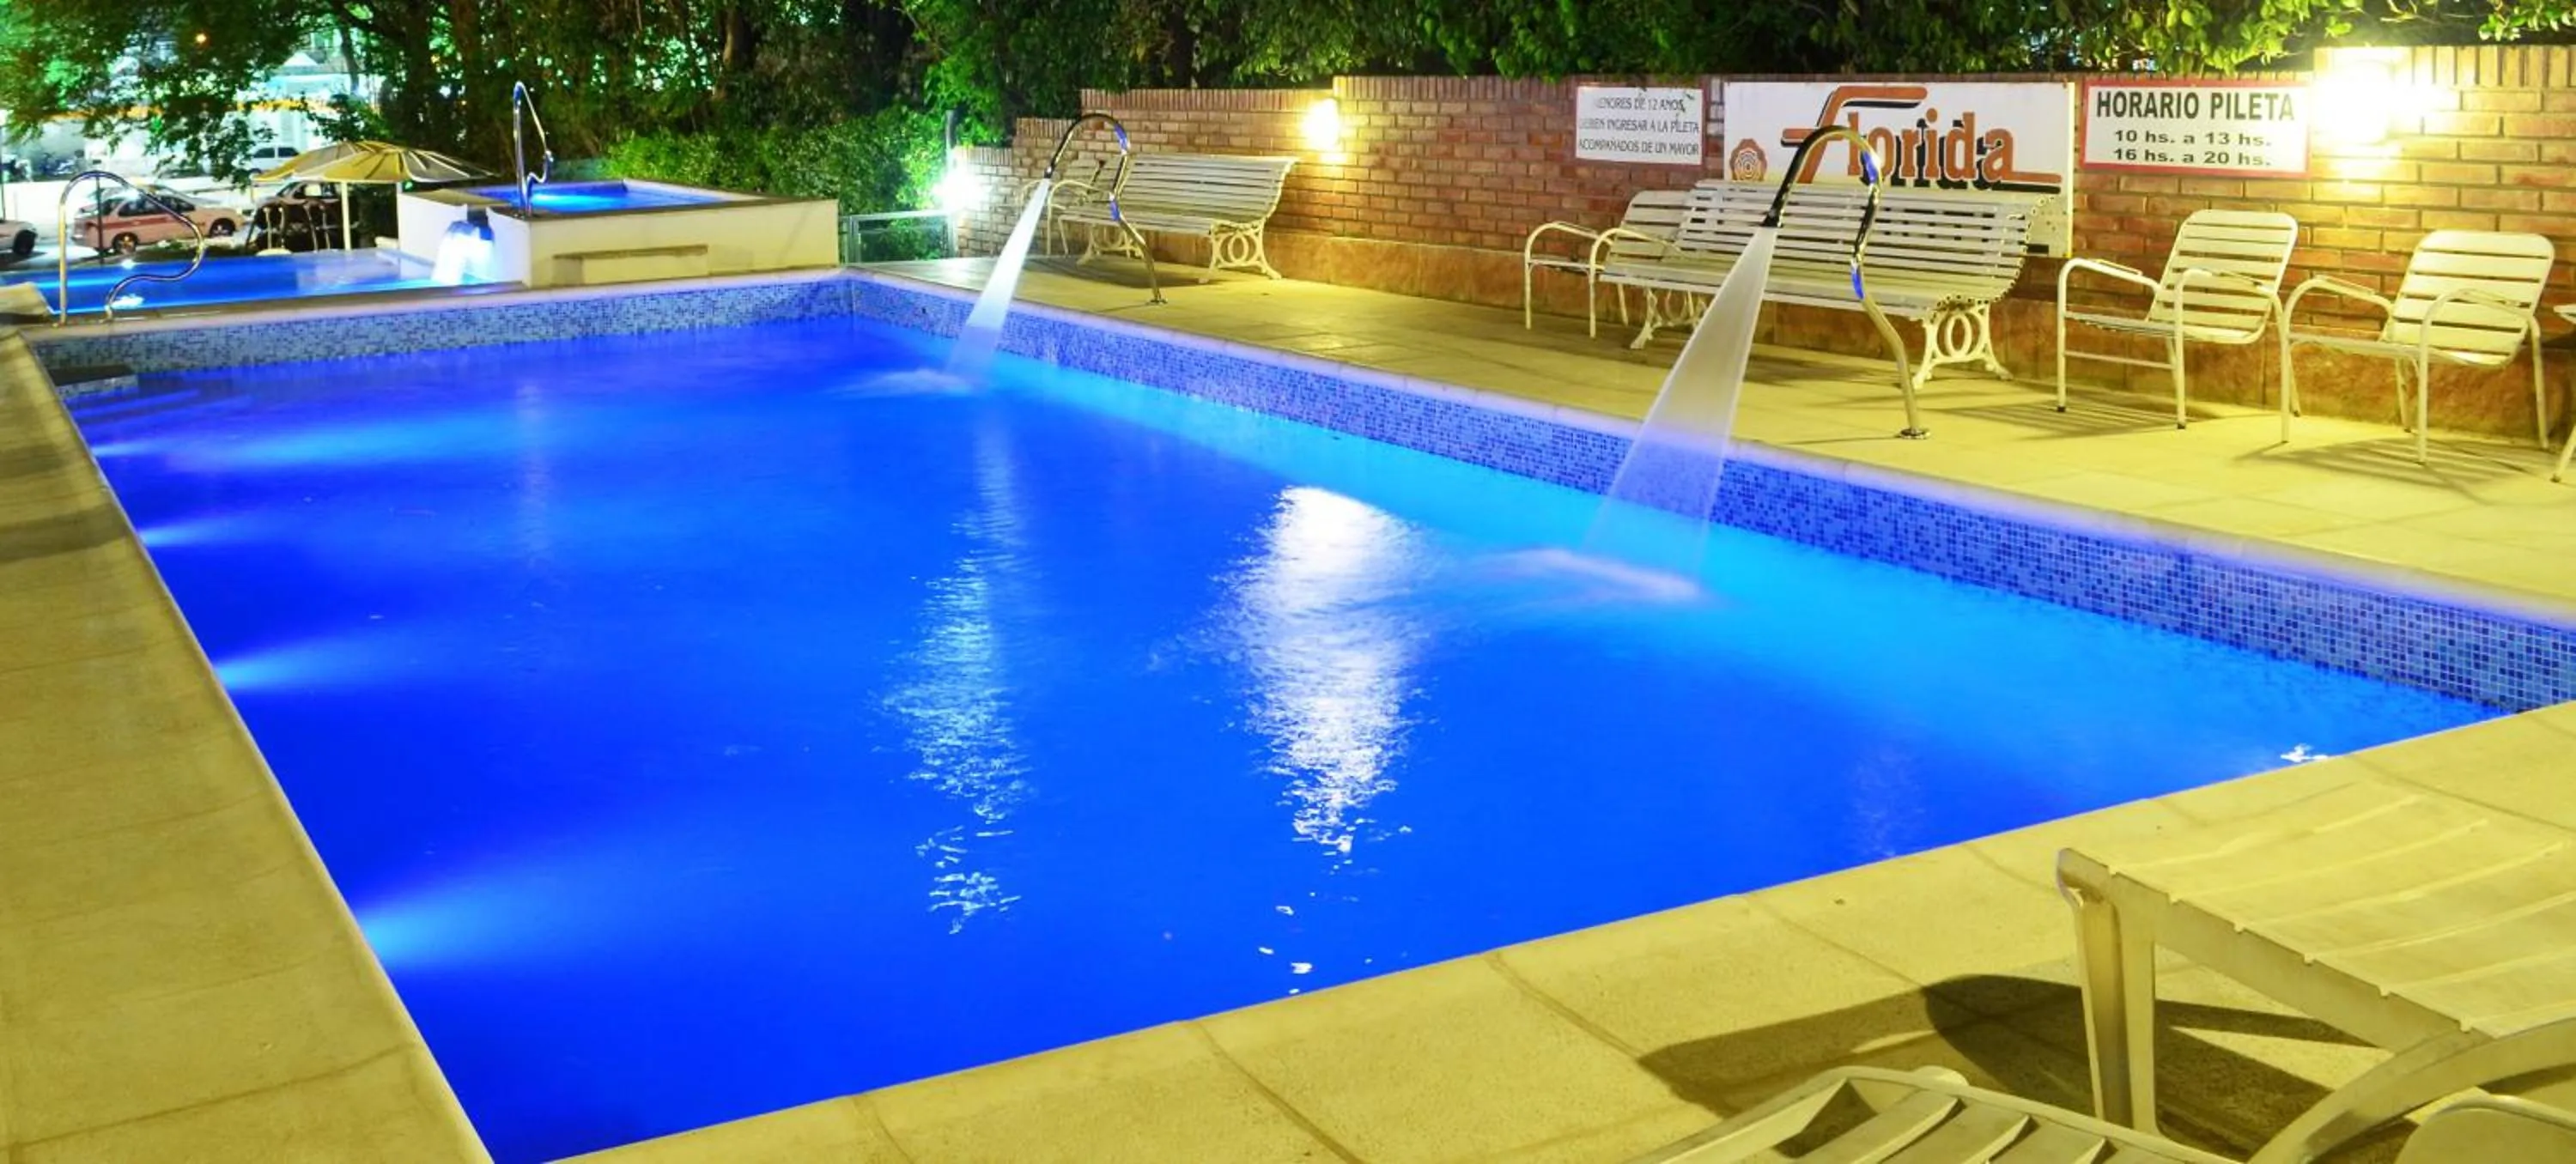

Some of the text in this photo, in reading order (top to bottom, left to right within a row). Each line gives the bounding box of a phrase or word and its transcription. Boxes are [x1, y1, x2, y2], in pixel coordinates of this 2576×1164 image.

[1590, 97, 1631, 110] ENORES
[1633, 98, 1645, 111] DE
[1648, 98, 1658, 111] 12
[2096, 91, 2294, 121] HORARIO PILETA
[1607, 118, 1648, 131] INGRESAR
[1650, 119, 1656, 132] A
[1657, 120, 1669, 133] LA
[1670, 121, 1699, 134] PILETA
[1782, 85, 2062, 189] Florida
[2115, 130, 2272, 147] 10 hs. a 13 hs.
[1641, 141, 1653, 154] DE
[1655, 142, 1667, 155] UN
[1668, 142, 1699, 156] MAYOR
[2114, 149, 2272, 167] 16 hs. a 20 hs.
